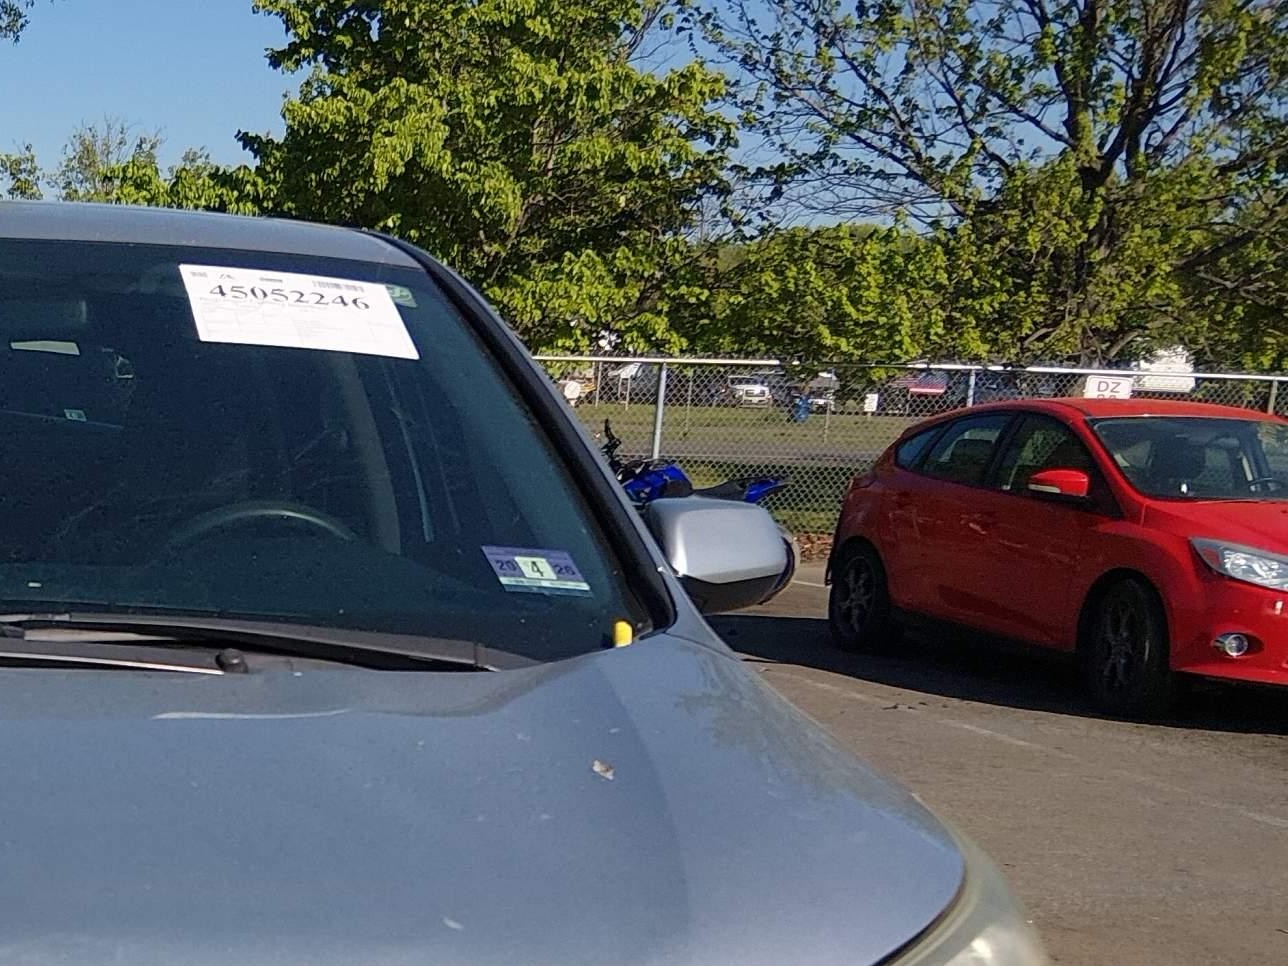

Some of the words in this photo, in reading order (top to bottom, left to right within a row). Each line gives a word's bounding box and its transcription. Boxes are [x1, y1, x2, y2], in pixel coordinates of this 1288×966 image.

[209, 284, 370, 310] 45052246
[1097, 380, 1122, 393] DZ
[496, 560, 517, 572] 20
[531, 561, 544, 577] 4
